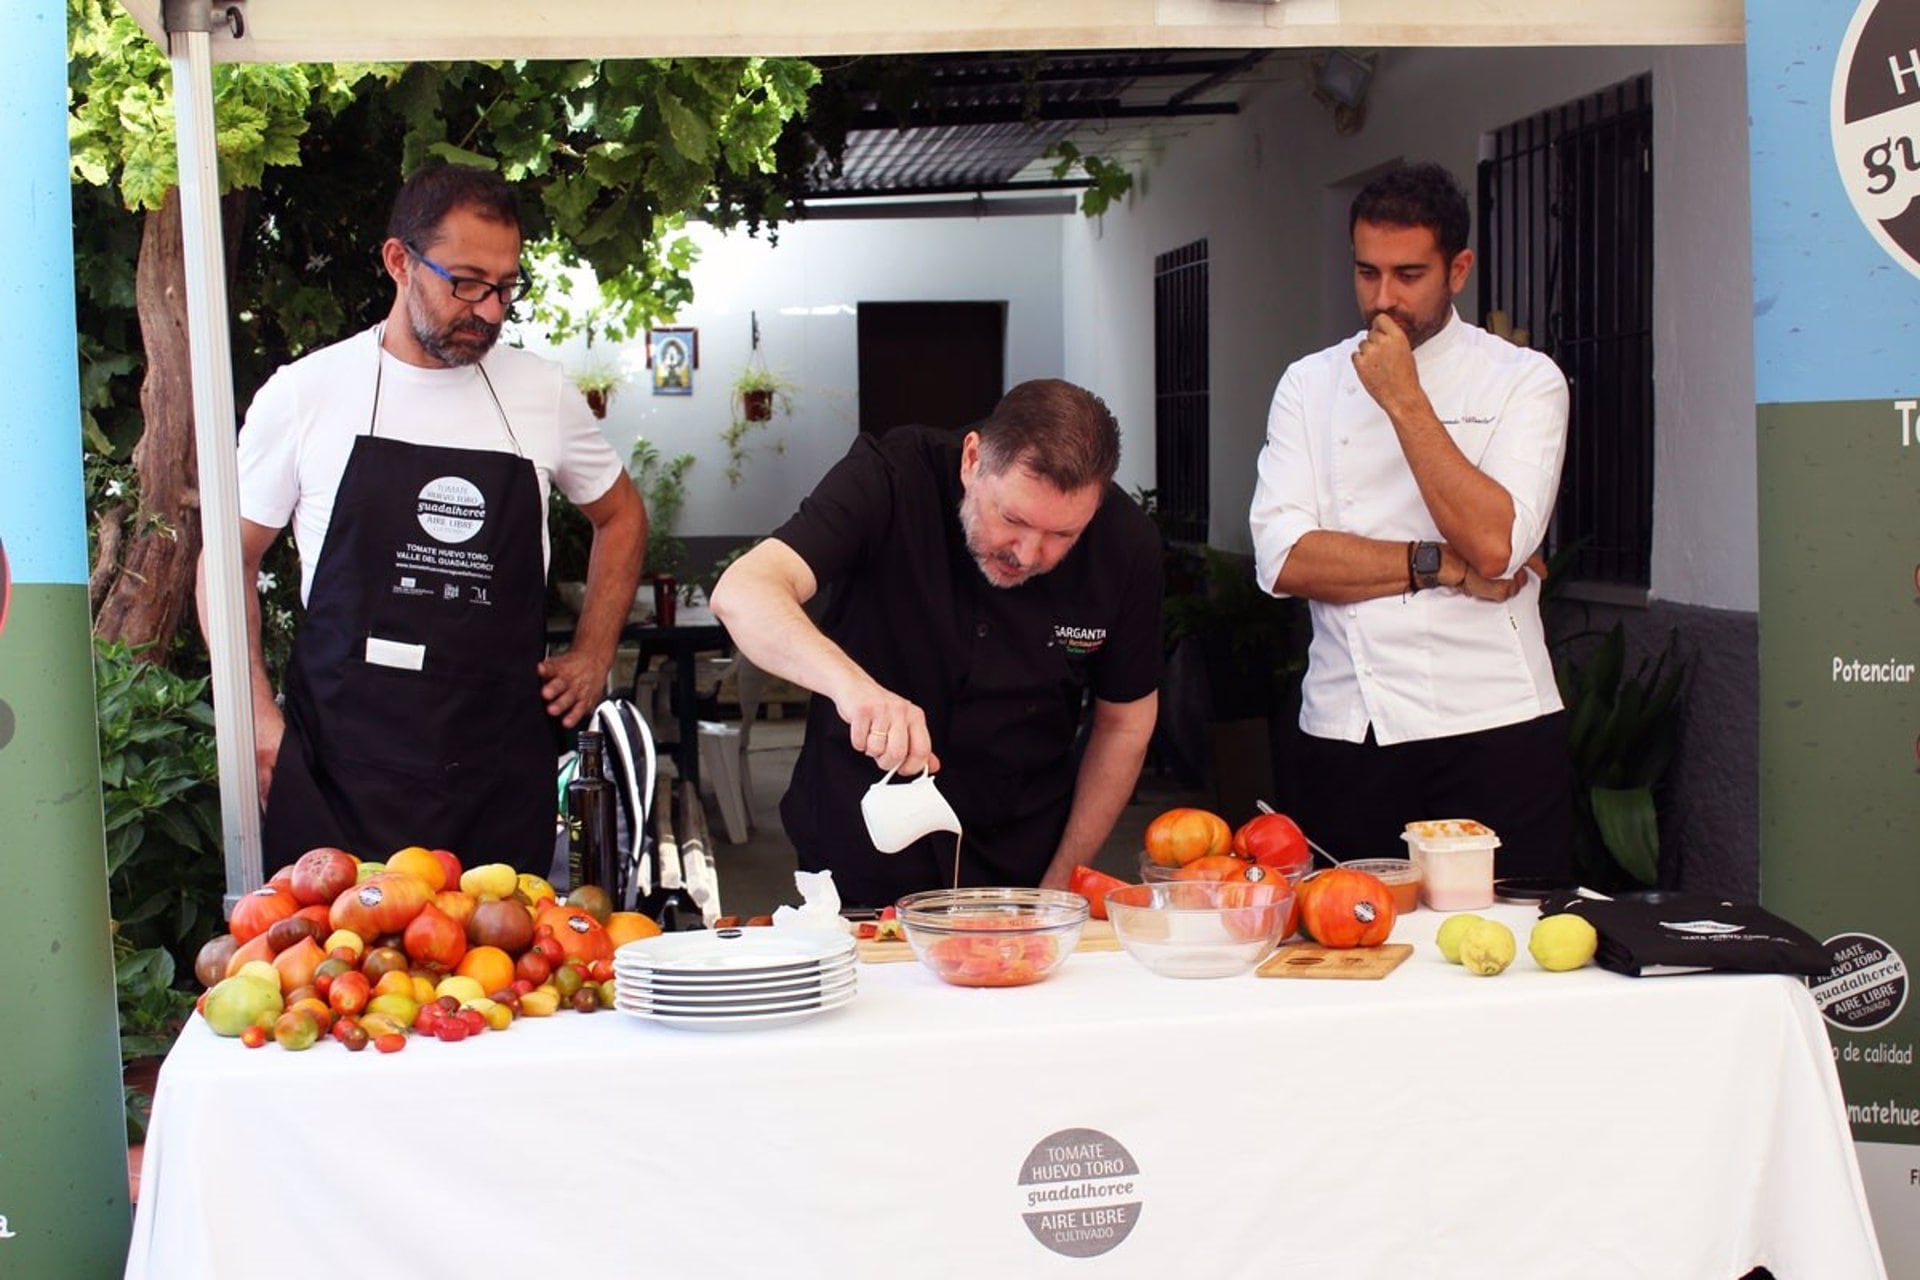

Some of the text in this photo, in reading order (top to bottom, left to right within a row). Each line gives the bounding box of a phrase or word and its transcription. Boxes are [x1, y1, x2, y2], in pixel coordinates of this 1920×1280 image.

[427, 516, 473, 529] AIRE LIBRE
[396, 551, 420, 561] VALLE
[421, 555, 437, 564] DEL
[406, 543, 488, 562] TOMATE HUEVO TORO
[1832, 656, 1916, 682] Potenciar
[1853, 949, 1883, 968] TORO
[1815, 961, 1902, 1005] guadalhorce
[1834, 982, 1897, 1015] AIRE LIBRE
[1847, 998, 1892, 1021] CULTIVADO
[1843, 1040, 1861, 1061] de
[1863, 1042, 1913, 1064] calidad
[1046, 1143, 1105, 1163] TOMATE
[1032, 1158, 1124, 1181] HUEVO TORO
[1027, 1182, 1134, 1207] guadalhorce
[1041, 1208, 1126, 1231] AIRE LIBRE
[1055, 1227, 1114, 1243] CULTIVADO
